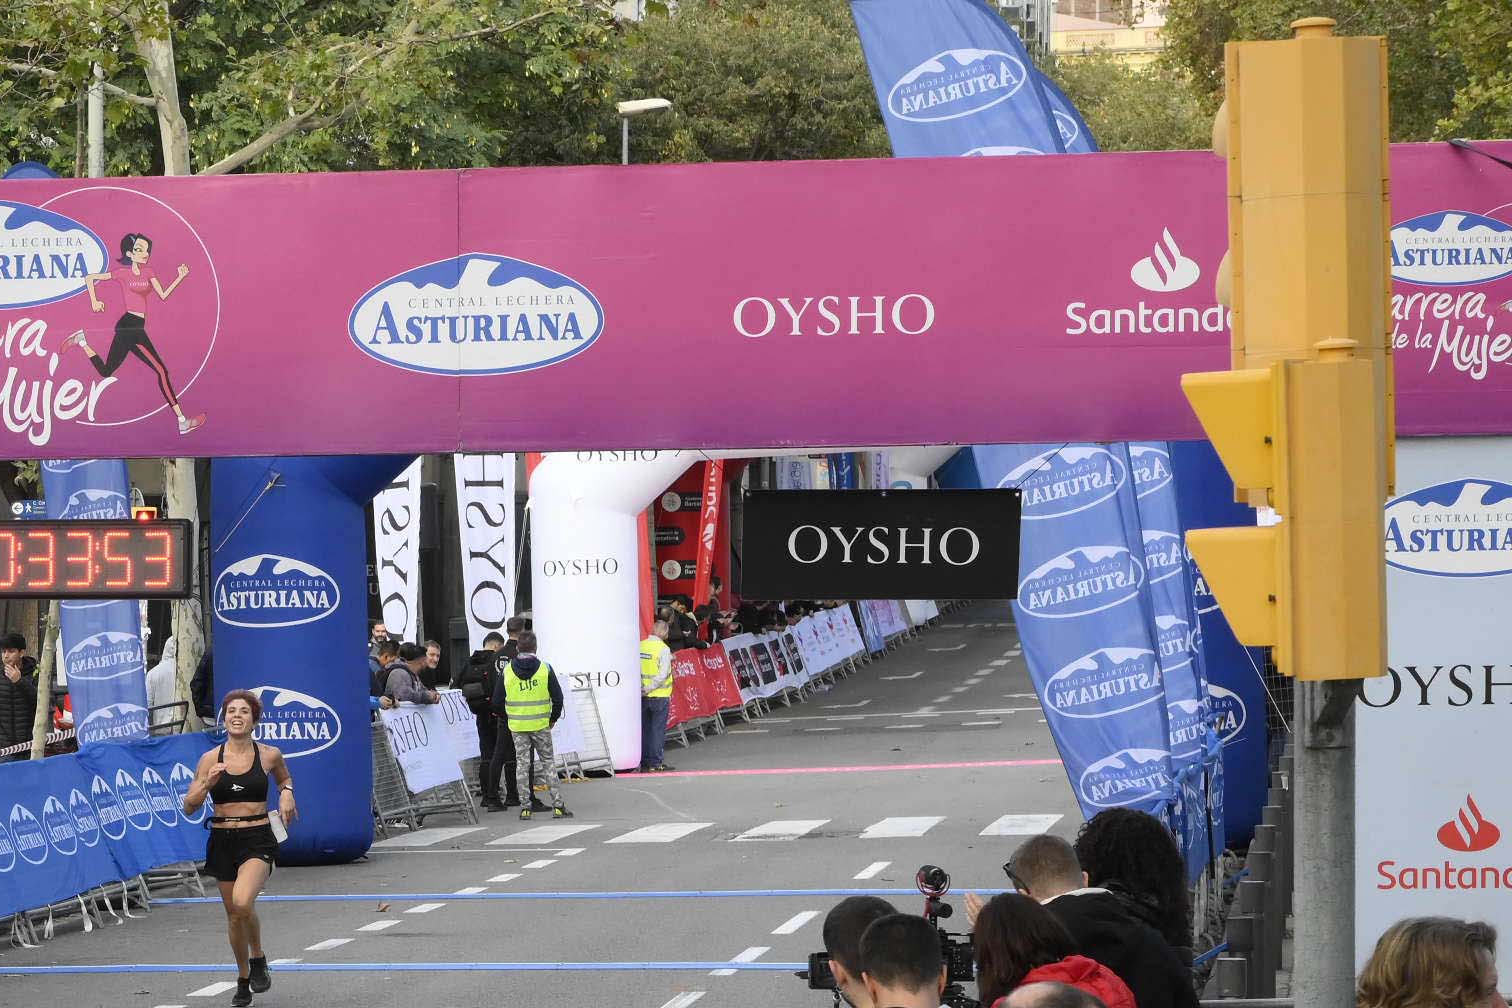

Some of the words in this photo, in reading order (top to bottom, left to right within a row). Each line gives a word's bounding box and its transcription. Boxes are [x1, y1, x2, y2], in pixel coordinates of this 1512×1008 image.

[12, 237, 83, 248] LECHERA
[1405, 236, 1458, 245] CENTRAL
[408, 299, 485, 309] CENTRAL
[492, 296, 575, 308] LECHERA
[1391, 291, 1486, 320] arrera
[369, 302, 584, 345] ASTURIANA
[733, 294, 935, 338] OYSHO
[1066, 302, 1232, 335] Santand
[1414, 321, 1433, 349] la
[1428, 315, 1512, 380] Muje
[1412, 513, 1478, 524] CENTRAL
[787, 524, 980, 566] OYSHO
[543, 557, 619, 577] OYSHO
[230, 580, 273, 588] CENTRAL
[277, 579, 326, 587] LECHERA
[218, 584, 331, 611] ASTURIANA
[519, 678, 538, 692] Life
[573, 670, 621, 688] SHO
[1358, 663, 1512, 708] OYSH
[277, 711, 326, 719] LECHERA
[251, 721, 331, 740] URIANA
